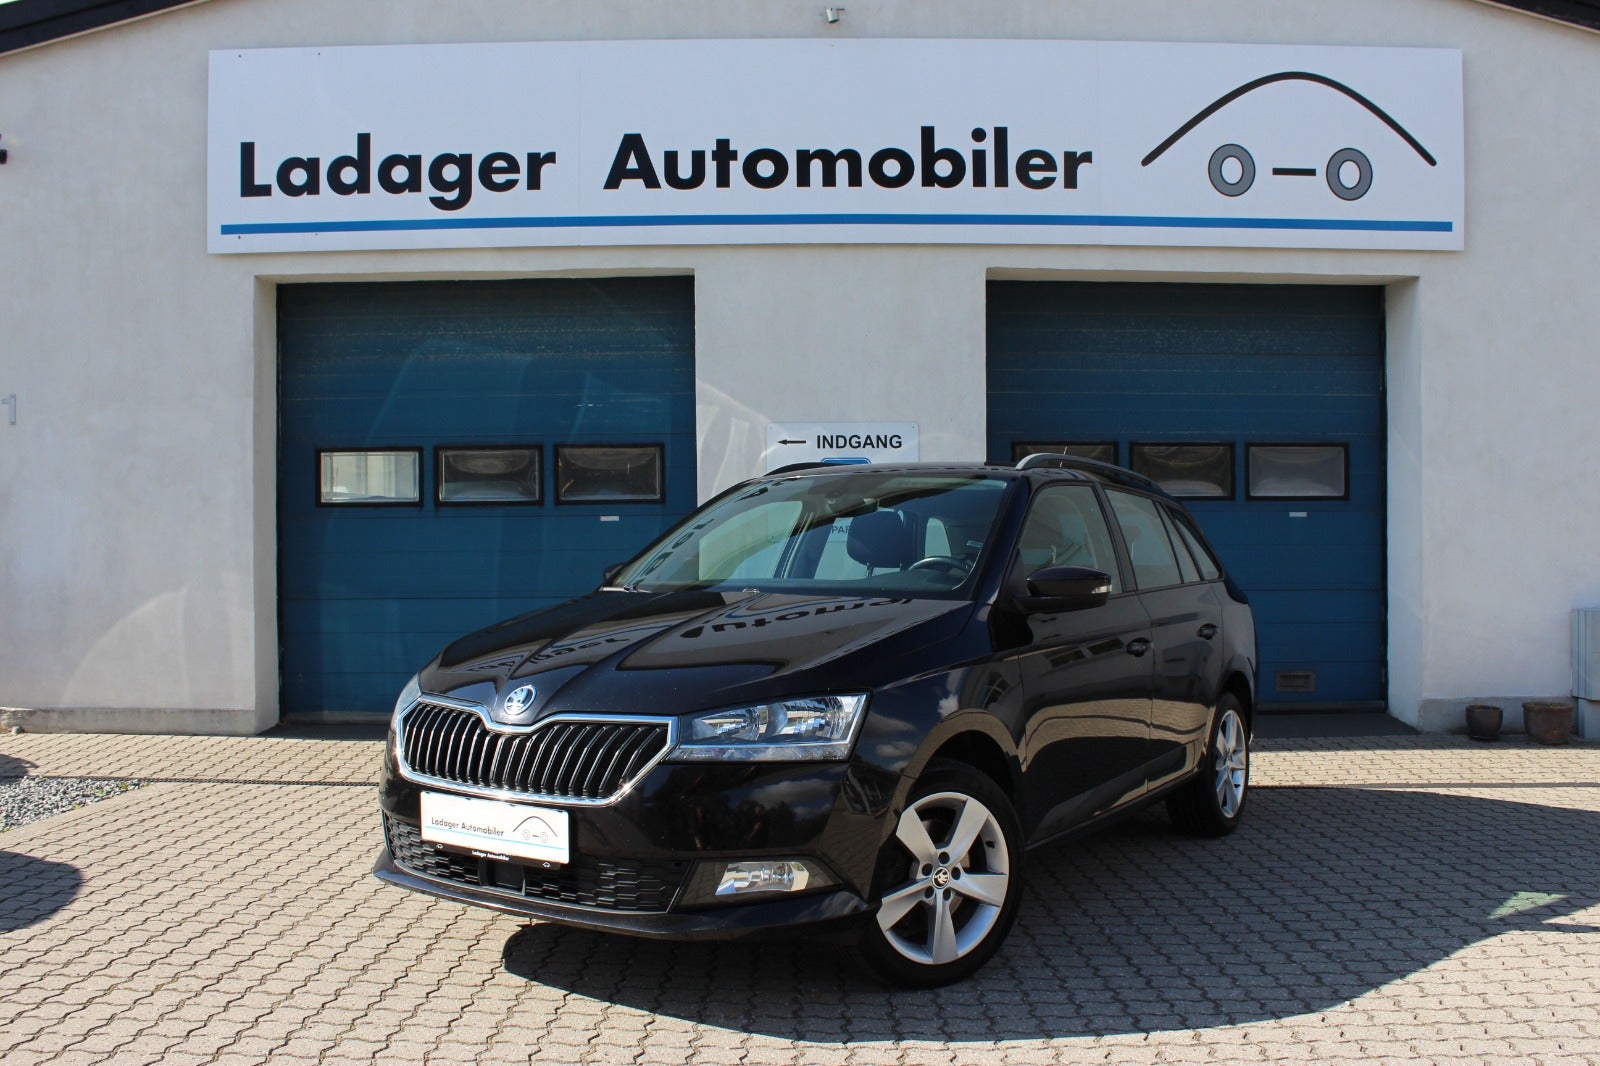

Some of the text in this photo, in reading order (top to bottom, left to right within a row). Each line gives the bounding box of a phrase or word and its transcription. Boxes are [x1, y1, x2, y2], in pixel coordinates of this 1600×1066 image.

[241, 126, 1093, 212] Ladager Automobiler
[816, 434, 903, 449] INDGANG
[431, 817, 504, 836] Ladager Automobiler
